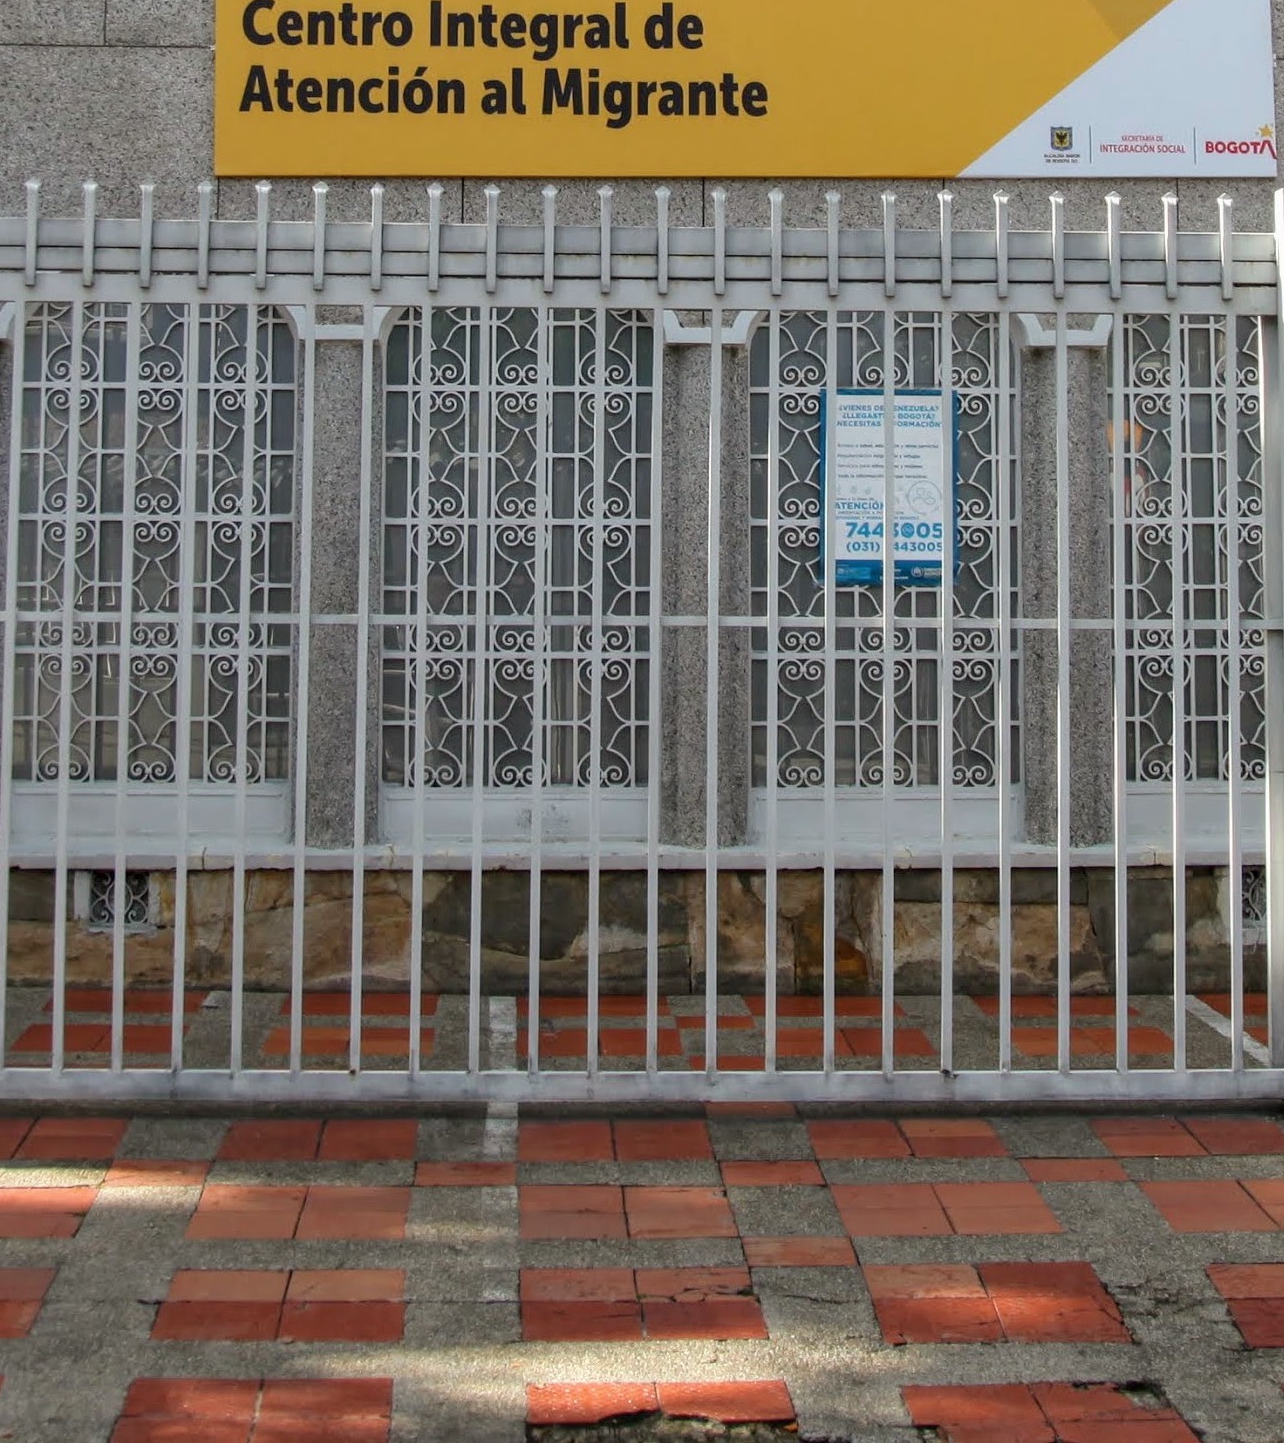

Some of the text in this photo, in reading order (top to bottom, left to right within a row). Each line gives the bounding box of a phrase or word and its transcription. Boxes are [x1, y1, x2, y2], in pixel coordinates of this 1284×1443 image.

[430, 0, 629, 61] Integral
[644, 2, 704, 50] de
[239, 65, 768, 129] Atención al Migrante
[1100, 142, 1186, 154] INTEGRACIÓN SOCIAL
[890, 404, 939, 412] ENEZUELA?
[846, 541, 942, 553] (031) 443005
